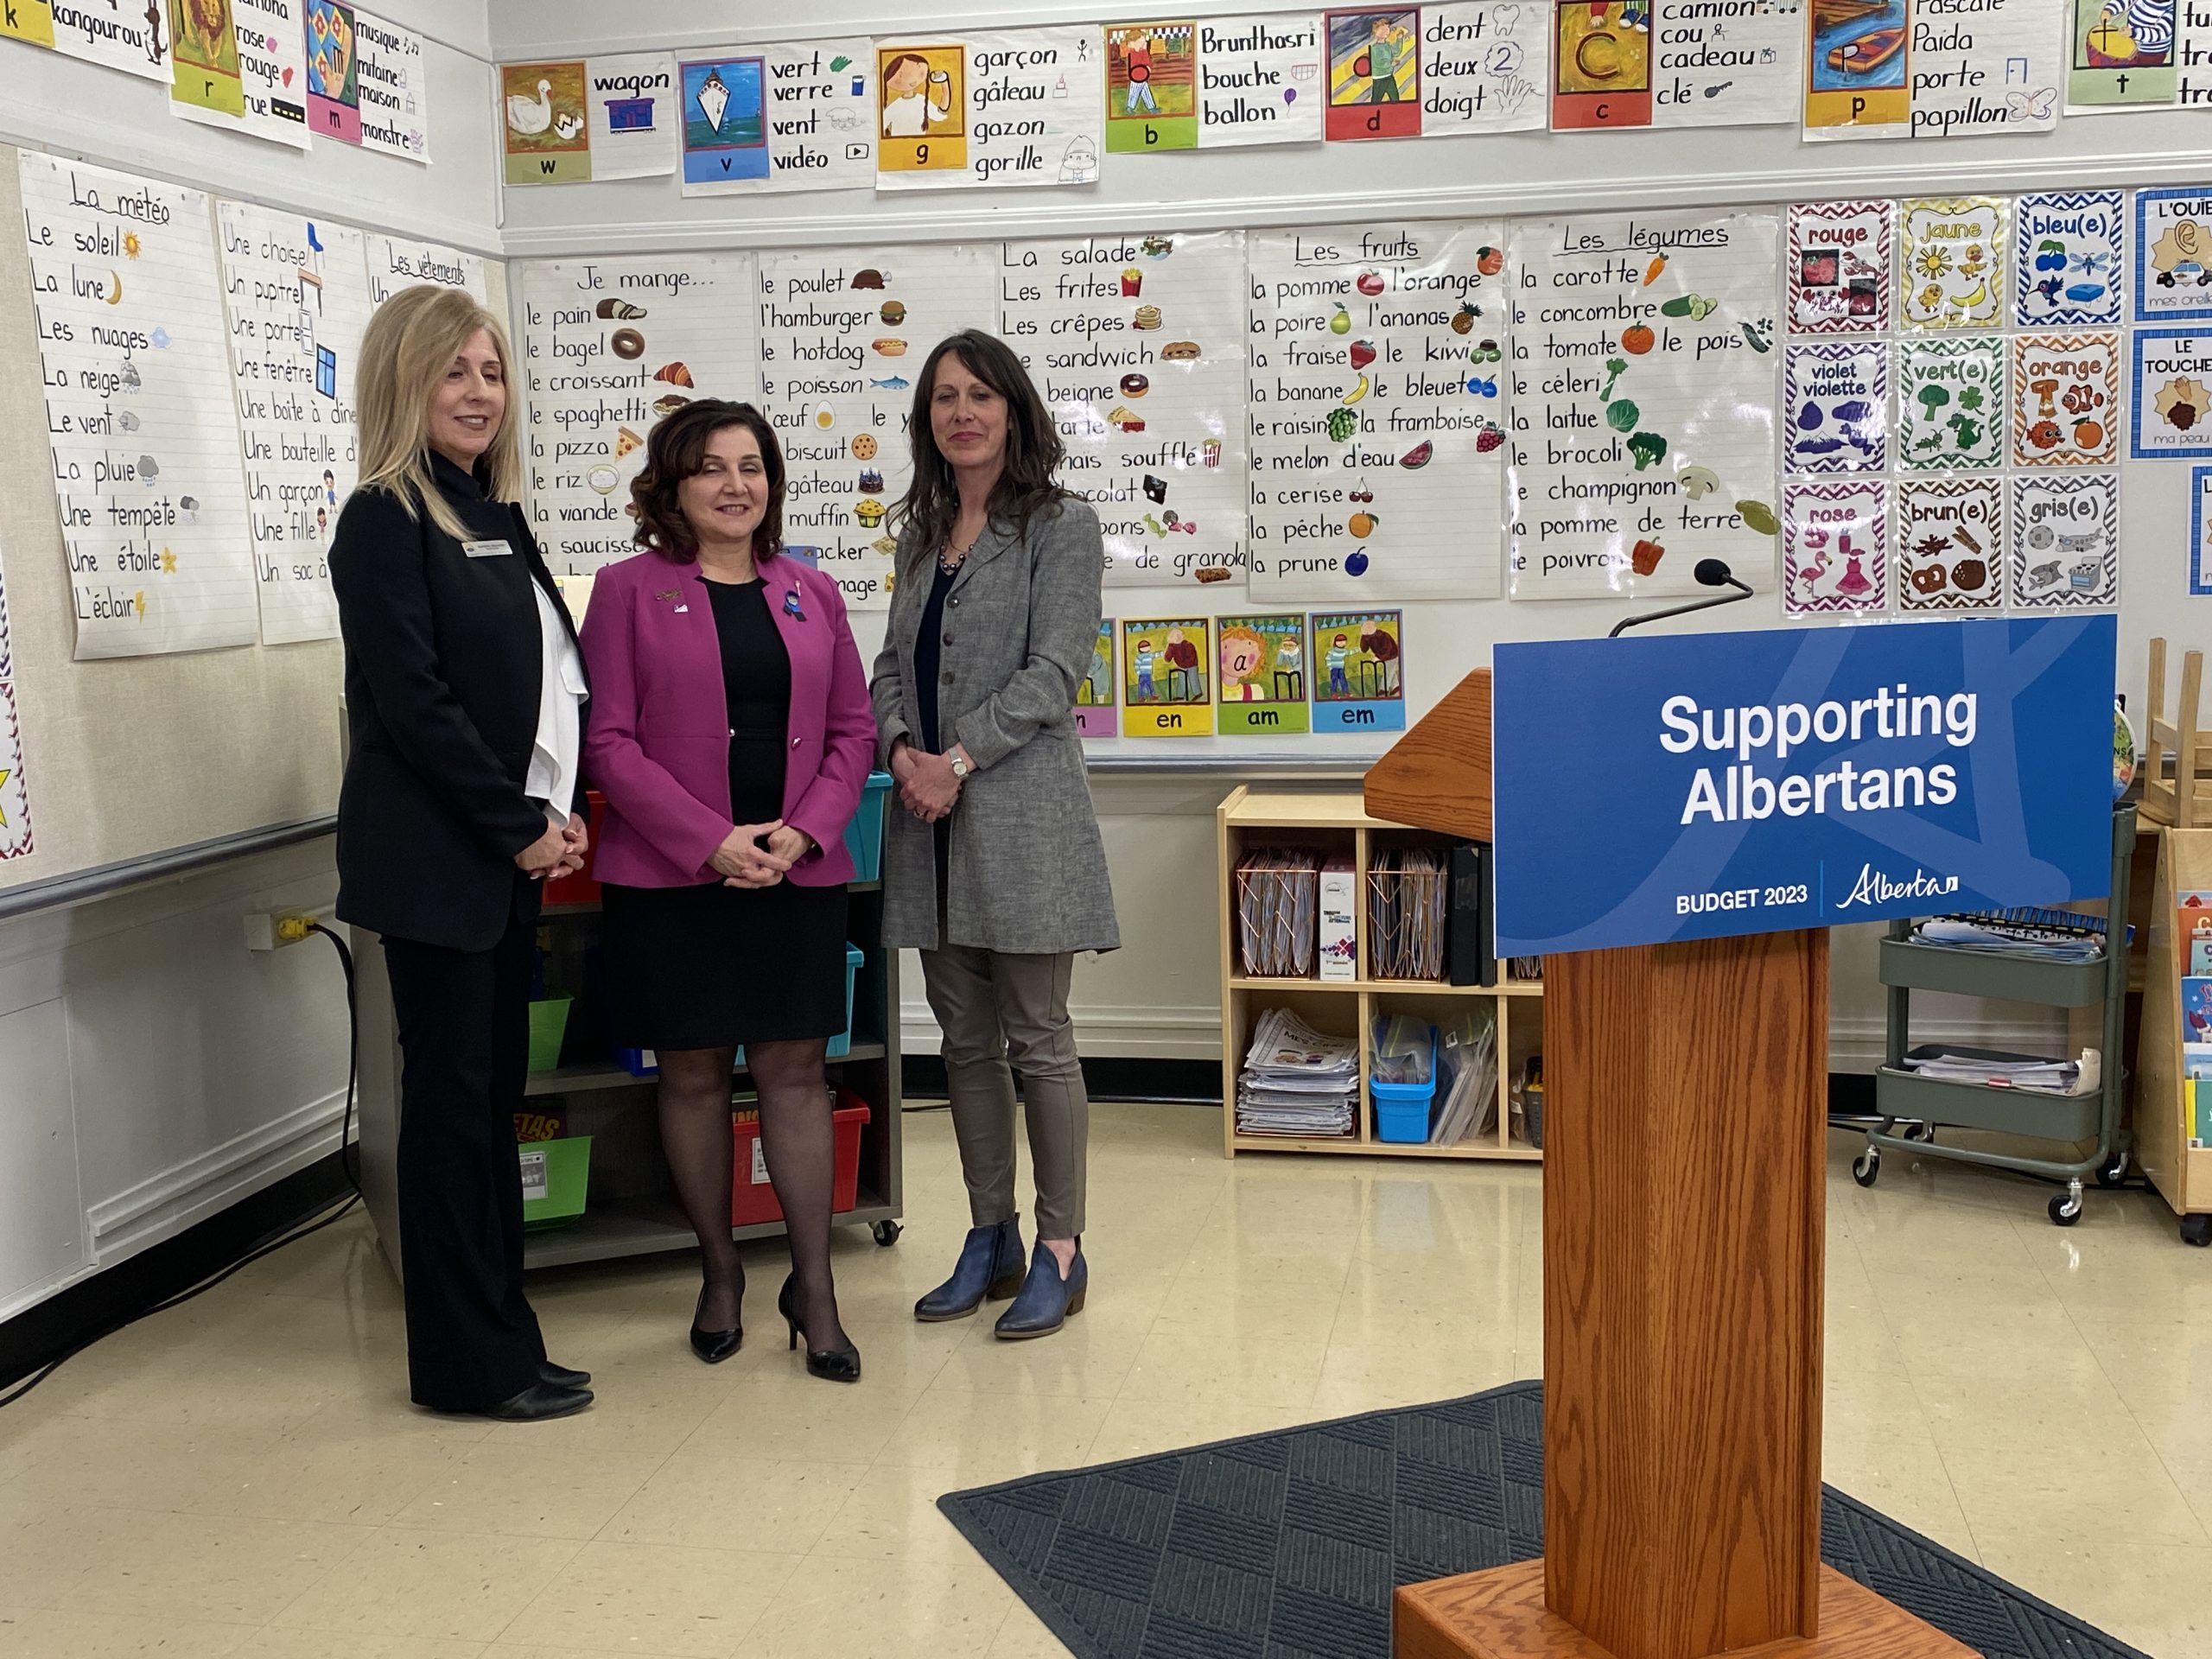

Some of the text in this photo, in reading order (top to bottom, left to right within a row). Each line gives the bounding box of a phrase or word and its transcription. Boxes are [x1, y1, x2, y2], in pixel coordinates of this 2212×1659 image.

[51, 0, 143, 48] kangourou
[235, 24, 265, 49] rose
[355, 21, 399, 54] musique
[1426, 13, 1485, 42] dent
[1661, 29, 1703, 44] cou
[1912, 22, 1974, 53] Paida
[1201, 24, 1315, 54] Brunthasri
[357, 53, 398, 86] mitaine
[771, 51, 821, 79] vert
[974, 49, 1057, 78] garçon
[1425, 50, 1477, 79] deux
[1494, 48, 1515, 72] 2
[1660, 42, 1755, 68] cadeau
[238, 53, 279, 88] rouge
[1202, 60, 1281, 90] bouche
[1912, 60, 1986, 101] porte
[2116, 73, 2130, 94] t
[204, 79, 214, 97] r
[359, 84, 400, 111] maison
[594, 73, 670, 99] wagon
[773, 84, 834, 102] verre
[973, 75, 1046, 111] gâteau
[1657, 77, 1694, 105] clé
[243, 95, 268, 117] rue
[1203, 97, 1276, 126] ballon
[1425, 85, 1485, 119] doigt
[1595, 104, 1609, 120] c
[1852, 96, 1866, 119] p
[328, 109, 341, 129] m
[772, 108, 821, 136] vent
[1366, 110, 1381, 131] d
[1910, 97, 2009, 138] papillon
[360, 119, 410, 149] monstre
[1144, 124, 1159, 145] b
[541, 159, 556, 174] w
[721, 157, 733, 172] v
[773, 141, 829, 169] vidéo
[916, 143, 929, 164] g
[975, 145, 1044, 181] gorille
[70, 170, 170, 222] La météo
[25, 207, 119, 257] Le soleil
[1563, 220, 1729, 254] Les légumes
[1808, 226, 1869, 247] rouge
[1920, 220, 1982, 245] jaune
[2032, 213, 2107, 239] bleu(e)
[224, 222, 306, 266] Une chaise
[1003, 237, 1136, 268] La salade
[1296, 231, 1419, 261] Les fruits
[389, 243, 466, 283] Les vêtements
[576, 265, 605, 290] Je
[1521, 258, 1639, 289] la carotte
[760, 267, 845, 303] le poulet
[1251, 274, 1351, 309] la pomme
[1393, 266, 1482, 299] l'orange
[761, 302, 873, 334] l'hamburger
[1369, 302, 1450, 328] l'ananas
[1512, 294, 1657, 325] le concombre
[36, 304, 149, 360] Les nuages
[1002, 311, 1125, 341] Les crêpes
[526, 332, 604, 367] le bagel
[761, 336, 864, 371] le hotdog
[1046, 340, 1154, 369] sandwich
[1250, 340, 1347, 368] la fraise
[1512, 330, 1618, 360] la tomate
[2175, 340, 2193, 353] LE
[233, 347, 314, 384] Une fenêtre
[528, 363, 652, 391] le croissant
[1811, 362, 1857, 380] violet
[1914, 359, 1988, 385] vert(e)
[2029, 358, 2103, 382] orange
[1250, 377, 1344, 403] la banane
[1373, 370, 1467, 398] le bleuet
[1802, 378, 1866, 397] violette
[46, 398, 113, 435] Le vent
[529, 398, 646, 432] le spaghetti
[1360, 407, 1484, 434] la framboise
[243, 430, 337, 463] Une bouteille
[531, 434, 609, 464] la pizza
[785, 436, 848, 461] biscuit
[1512, 436, 1623, 466] le brocoli
[2154, 434, 2210, 447] ma peau
[52, 447, 135, 495] La pluie
[1250, 442, 1395, 471] le melon d'eau
[787, 470, 854, 502] gâteau
[1548, 474, 1677, 505] champignon
[58, 494, 175, 539] Une tempête
[789, 503, 849, 527] muffin
[1541, 505, 1741, 542] pomme de terre
[1809, 506, 1857, 523] rose
[1911, 499, 1988, 525] brun(e)
[2029, 496, 2099, 524] gris(e)
[253, 512, 317, 543] Une fille
[1250, 515, 1267, 540] la
[258, 554, 328, 583] Un sac à
[1135, 542, 1247, 577] de granola
[1250, 550, 1338, 578] la prune
[75, 587, 134, 620] L'éclair
[1156, 713, 1183, 730] en
[1247, 710, 1280, 727] am
[1341, 706, 1376, 726] em
[1657, 683, 1980, 760] Supporting
[1679, 760, 1958, 825] Albertans
[1675, 884, 1808, 915] BUDGET 2023
[1835, 862, 1949, 910] Alberta
